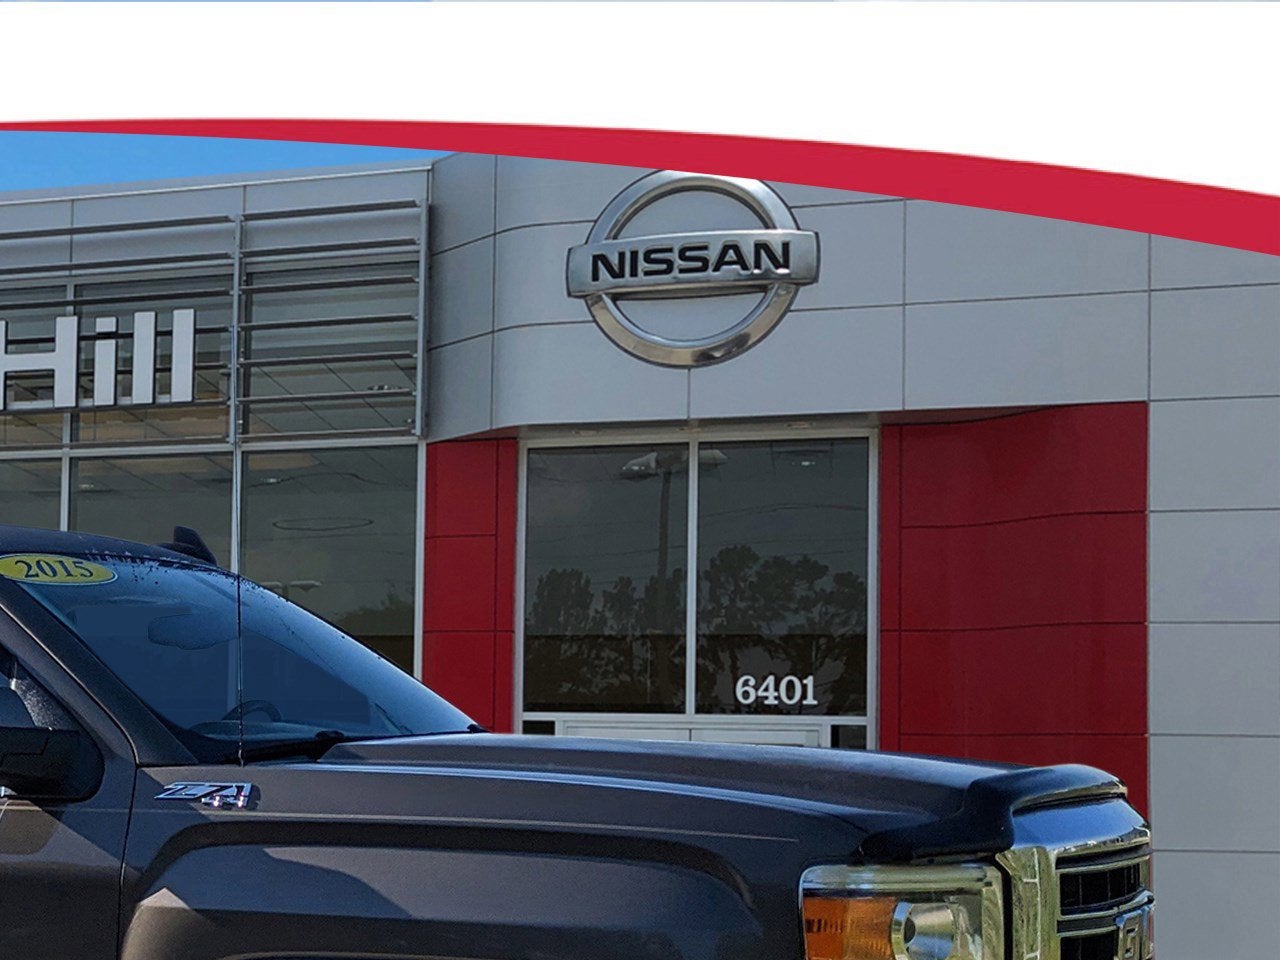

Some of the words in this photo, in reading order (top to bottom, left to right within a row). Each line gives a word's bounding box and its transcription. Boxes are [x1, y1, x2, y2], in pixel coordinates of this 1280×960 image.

[591, 240, 790, 283] NISSAN
[14, 560, 94, 579] 2015
[735, 674, 819, 705] 6401
